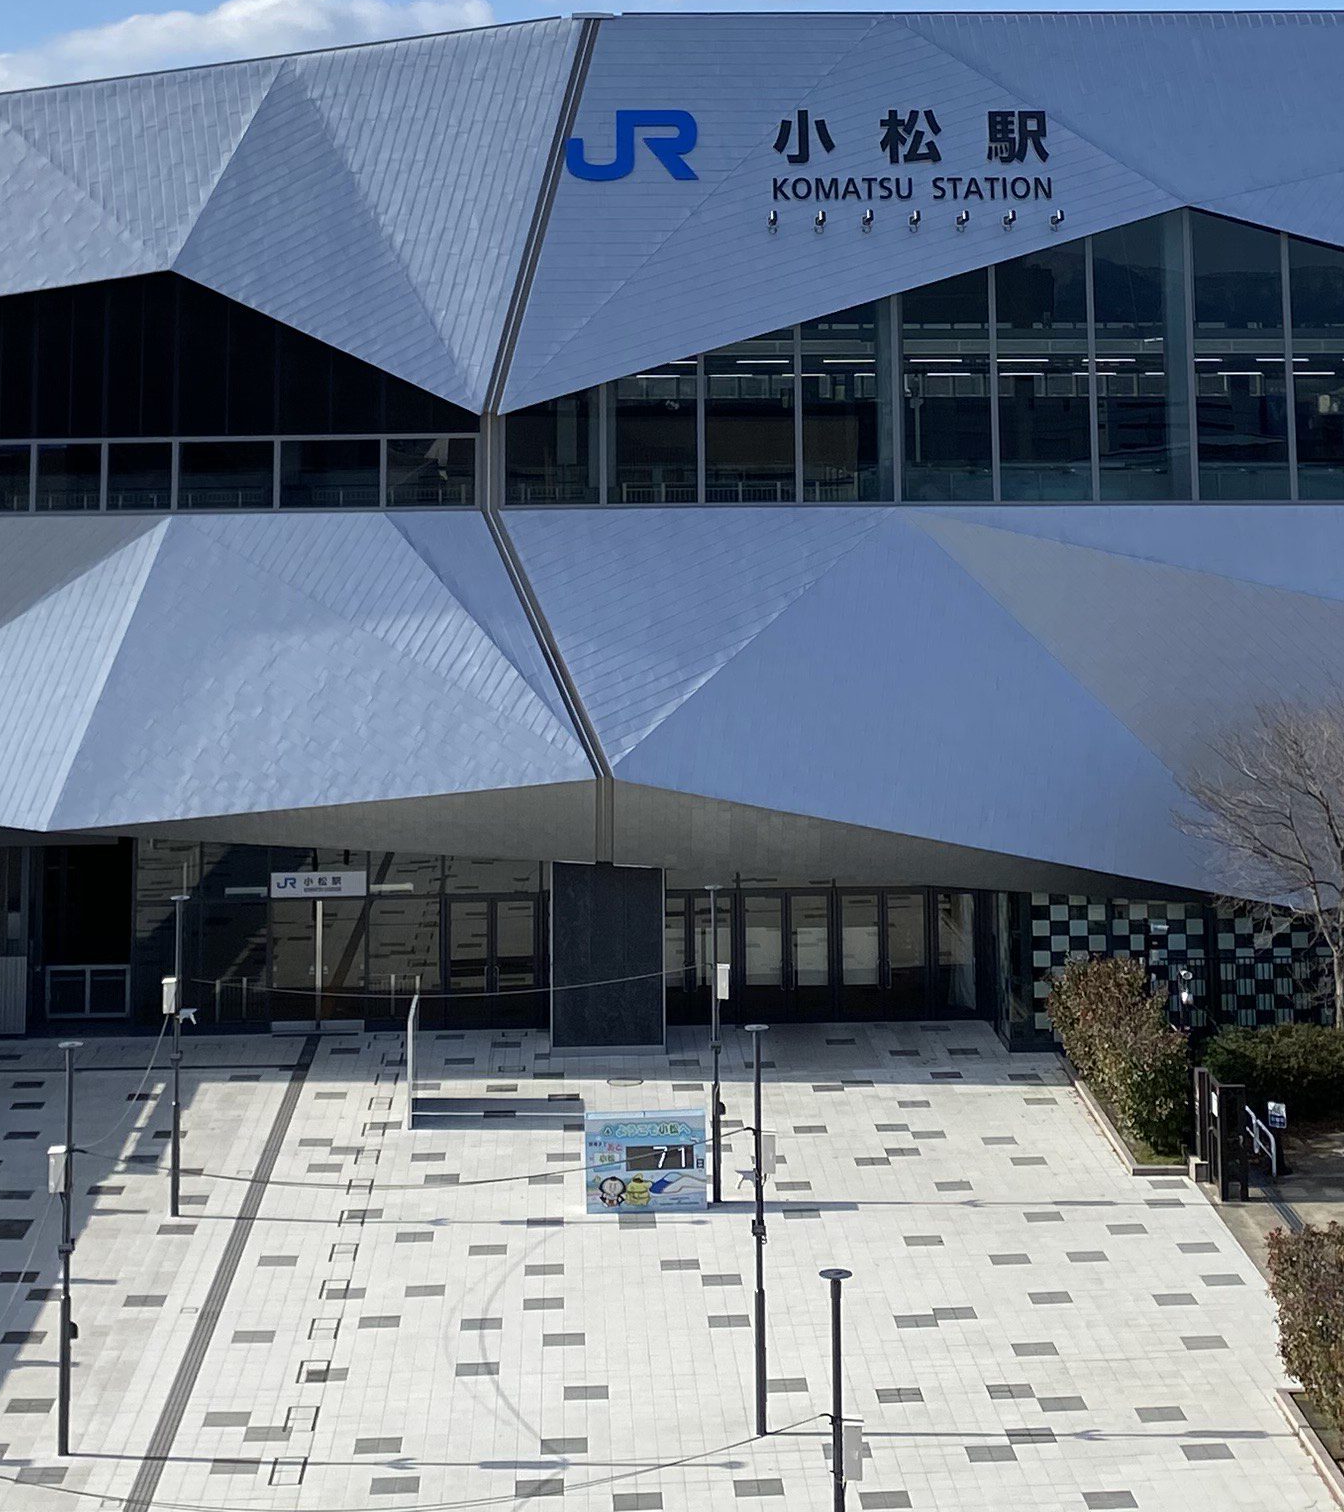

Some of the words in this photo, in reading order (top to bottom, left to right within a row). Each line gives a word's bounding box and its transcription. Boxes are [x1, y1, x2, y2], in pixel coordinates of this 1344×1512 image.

[566, 109, 699, 181] JR
[772, 109, 1050, 164] 小松駅
[771, 177, 913, 200] KOMATSU
[932, 176, 1053, 200] STATION
[277, 877, 297, 888] JR
[303, 876, 342, 887] 小松駅
[653, 1145, 686, 1168] 71
